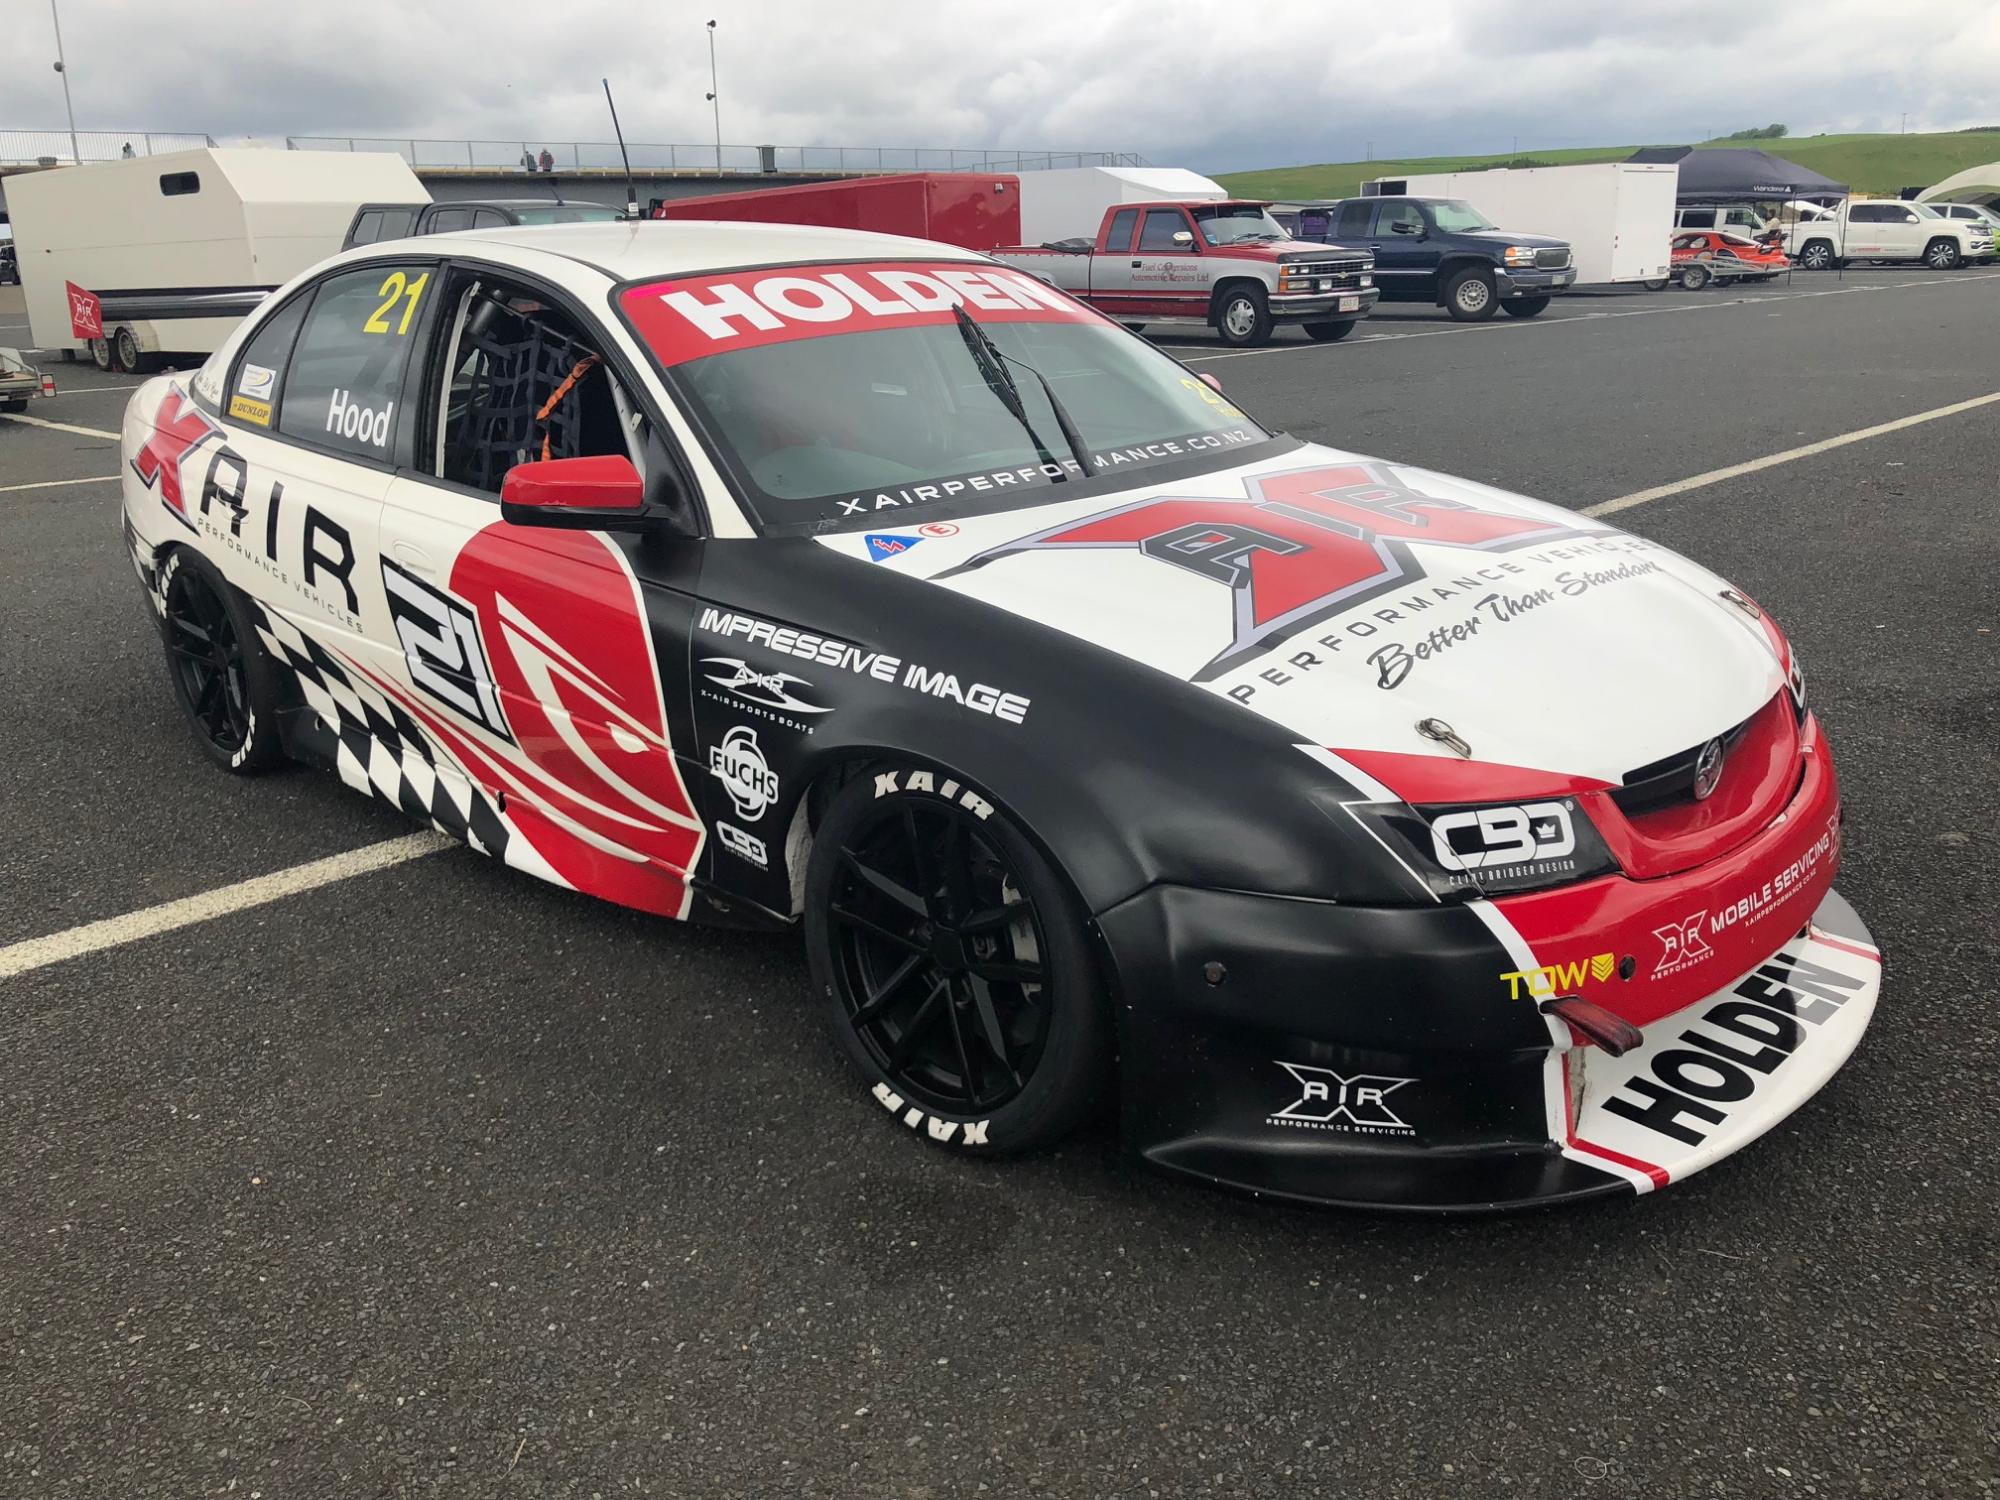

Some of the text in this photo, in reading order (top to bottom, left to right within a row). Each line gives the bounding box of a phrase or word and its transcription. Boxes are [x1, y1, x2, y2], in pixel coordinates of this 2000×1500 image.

[363, 271, 429, 335] 21
[659, 269, 1077, 340] HOLDEN
[237, 402, 269, 419] DUNLOP
[326, 388, 393, 447] Hood
[197, 516, 363, 634] PERFORMANCE VEHICLES
[1227, 560, 1525, 705] PERFORMANCE
[1366, 616, 1481, 692] Better
[1474, 585, 1556, 625] Than
[699, 608, 1031, 724] IMPRESSIVE IMAGE
[732, 700, 776, 721] SPORTS
[779, 716, 815, 735] BOATS
[712, 749, 778, 801] FUCHS
[1488, 865, 1535, 881] BRIDGER
[1540, 859, 1576, 875] DESIGN
[1711, 883, 1772, 934] MOBILE
[1774, 832, 1829, 895] SERVICING
[1500, 966, 1592, 1000] TOW
[1651, 949, 1714, 981] PERFORMANCE
[1600, 952, 1867, 1147] HOLDEN
[1266, 1118, 1416, 1136] PERFORMANCE SERVICING
